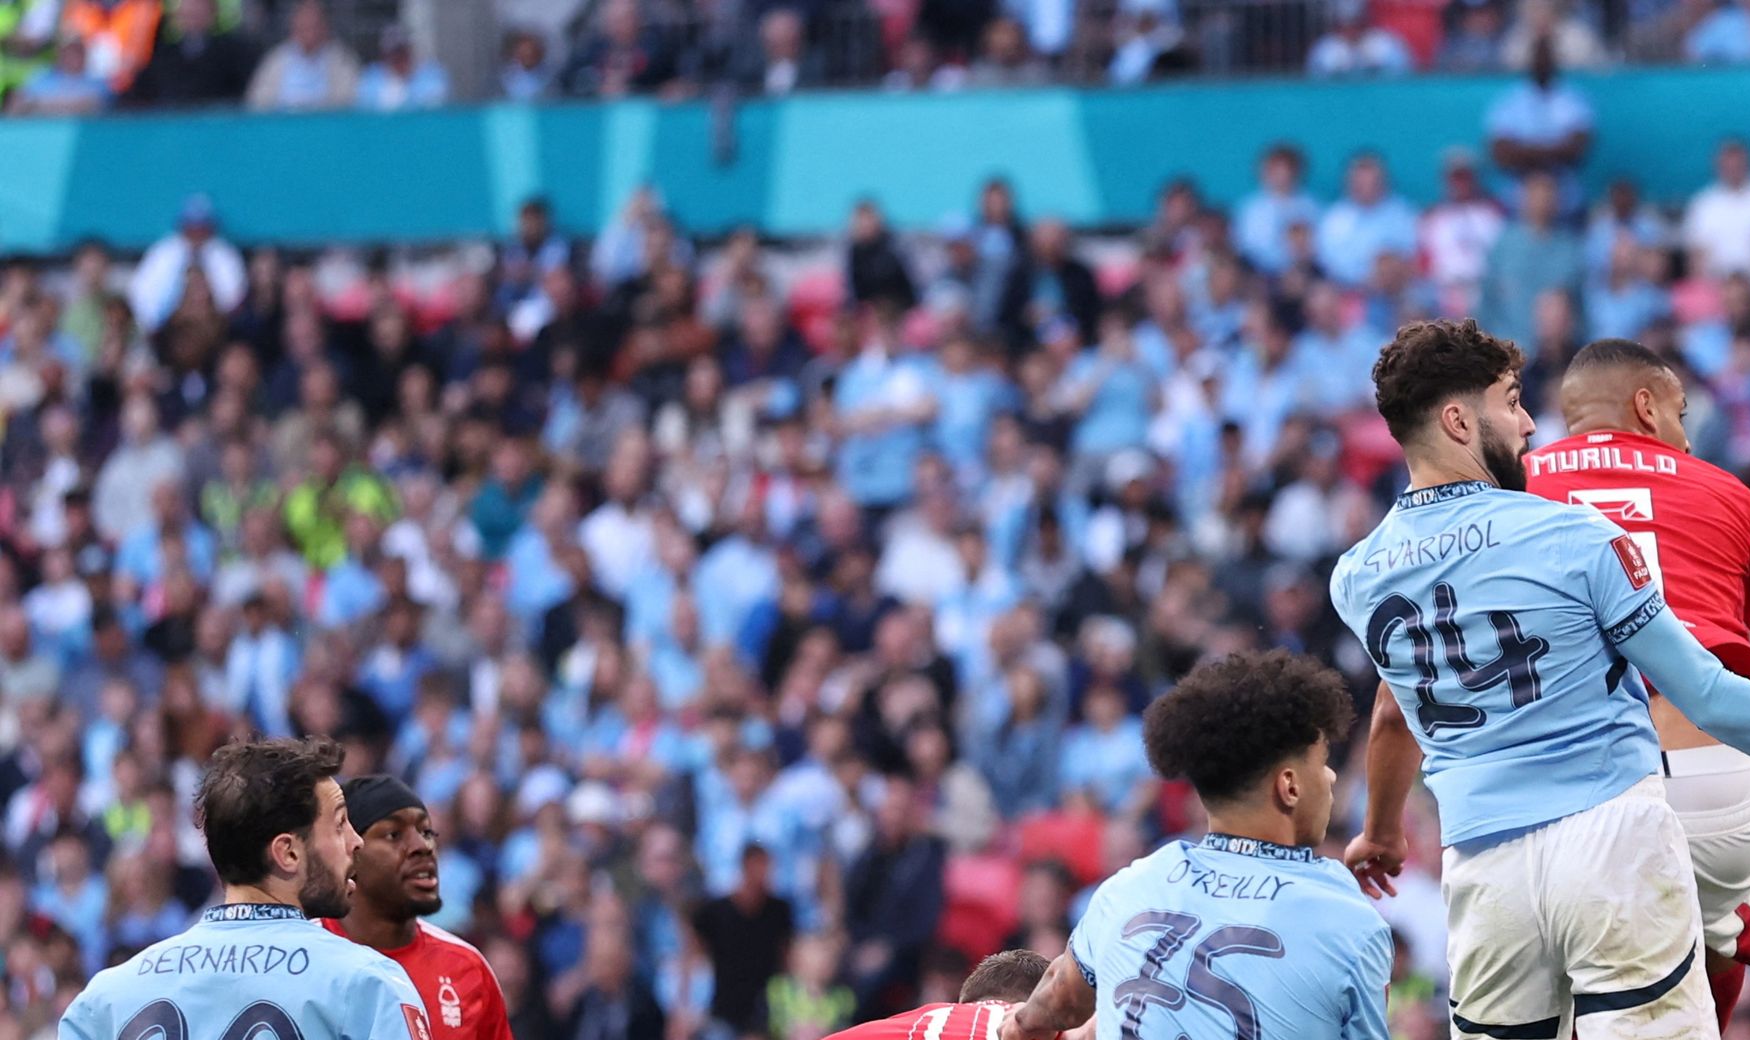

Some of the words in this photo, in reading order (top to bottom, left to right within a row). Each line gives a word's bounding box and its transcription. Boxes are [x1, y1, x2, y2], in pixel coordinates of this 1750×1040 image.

[1531, 447, 1678, 477] MURILLO
[1367, 581, 1550, 738] 24
[137, 945, 310, 976] BERNARDO
